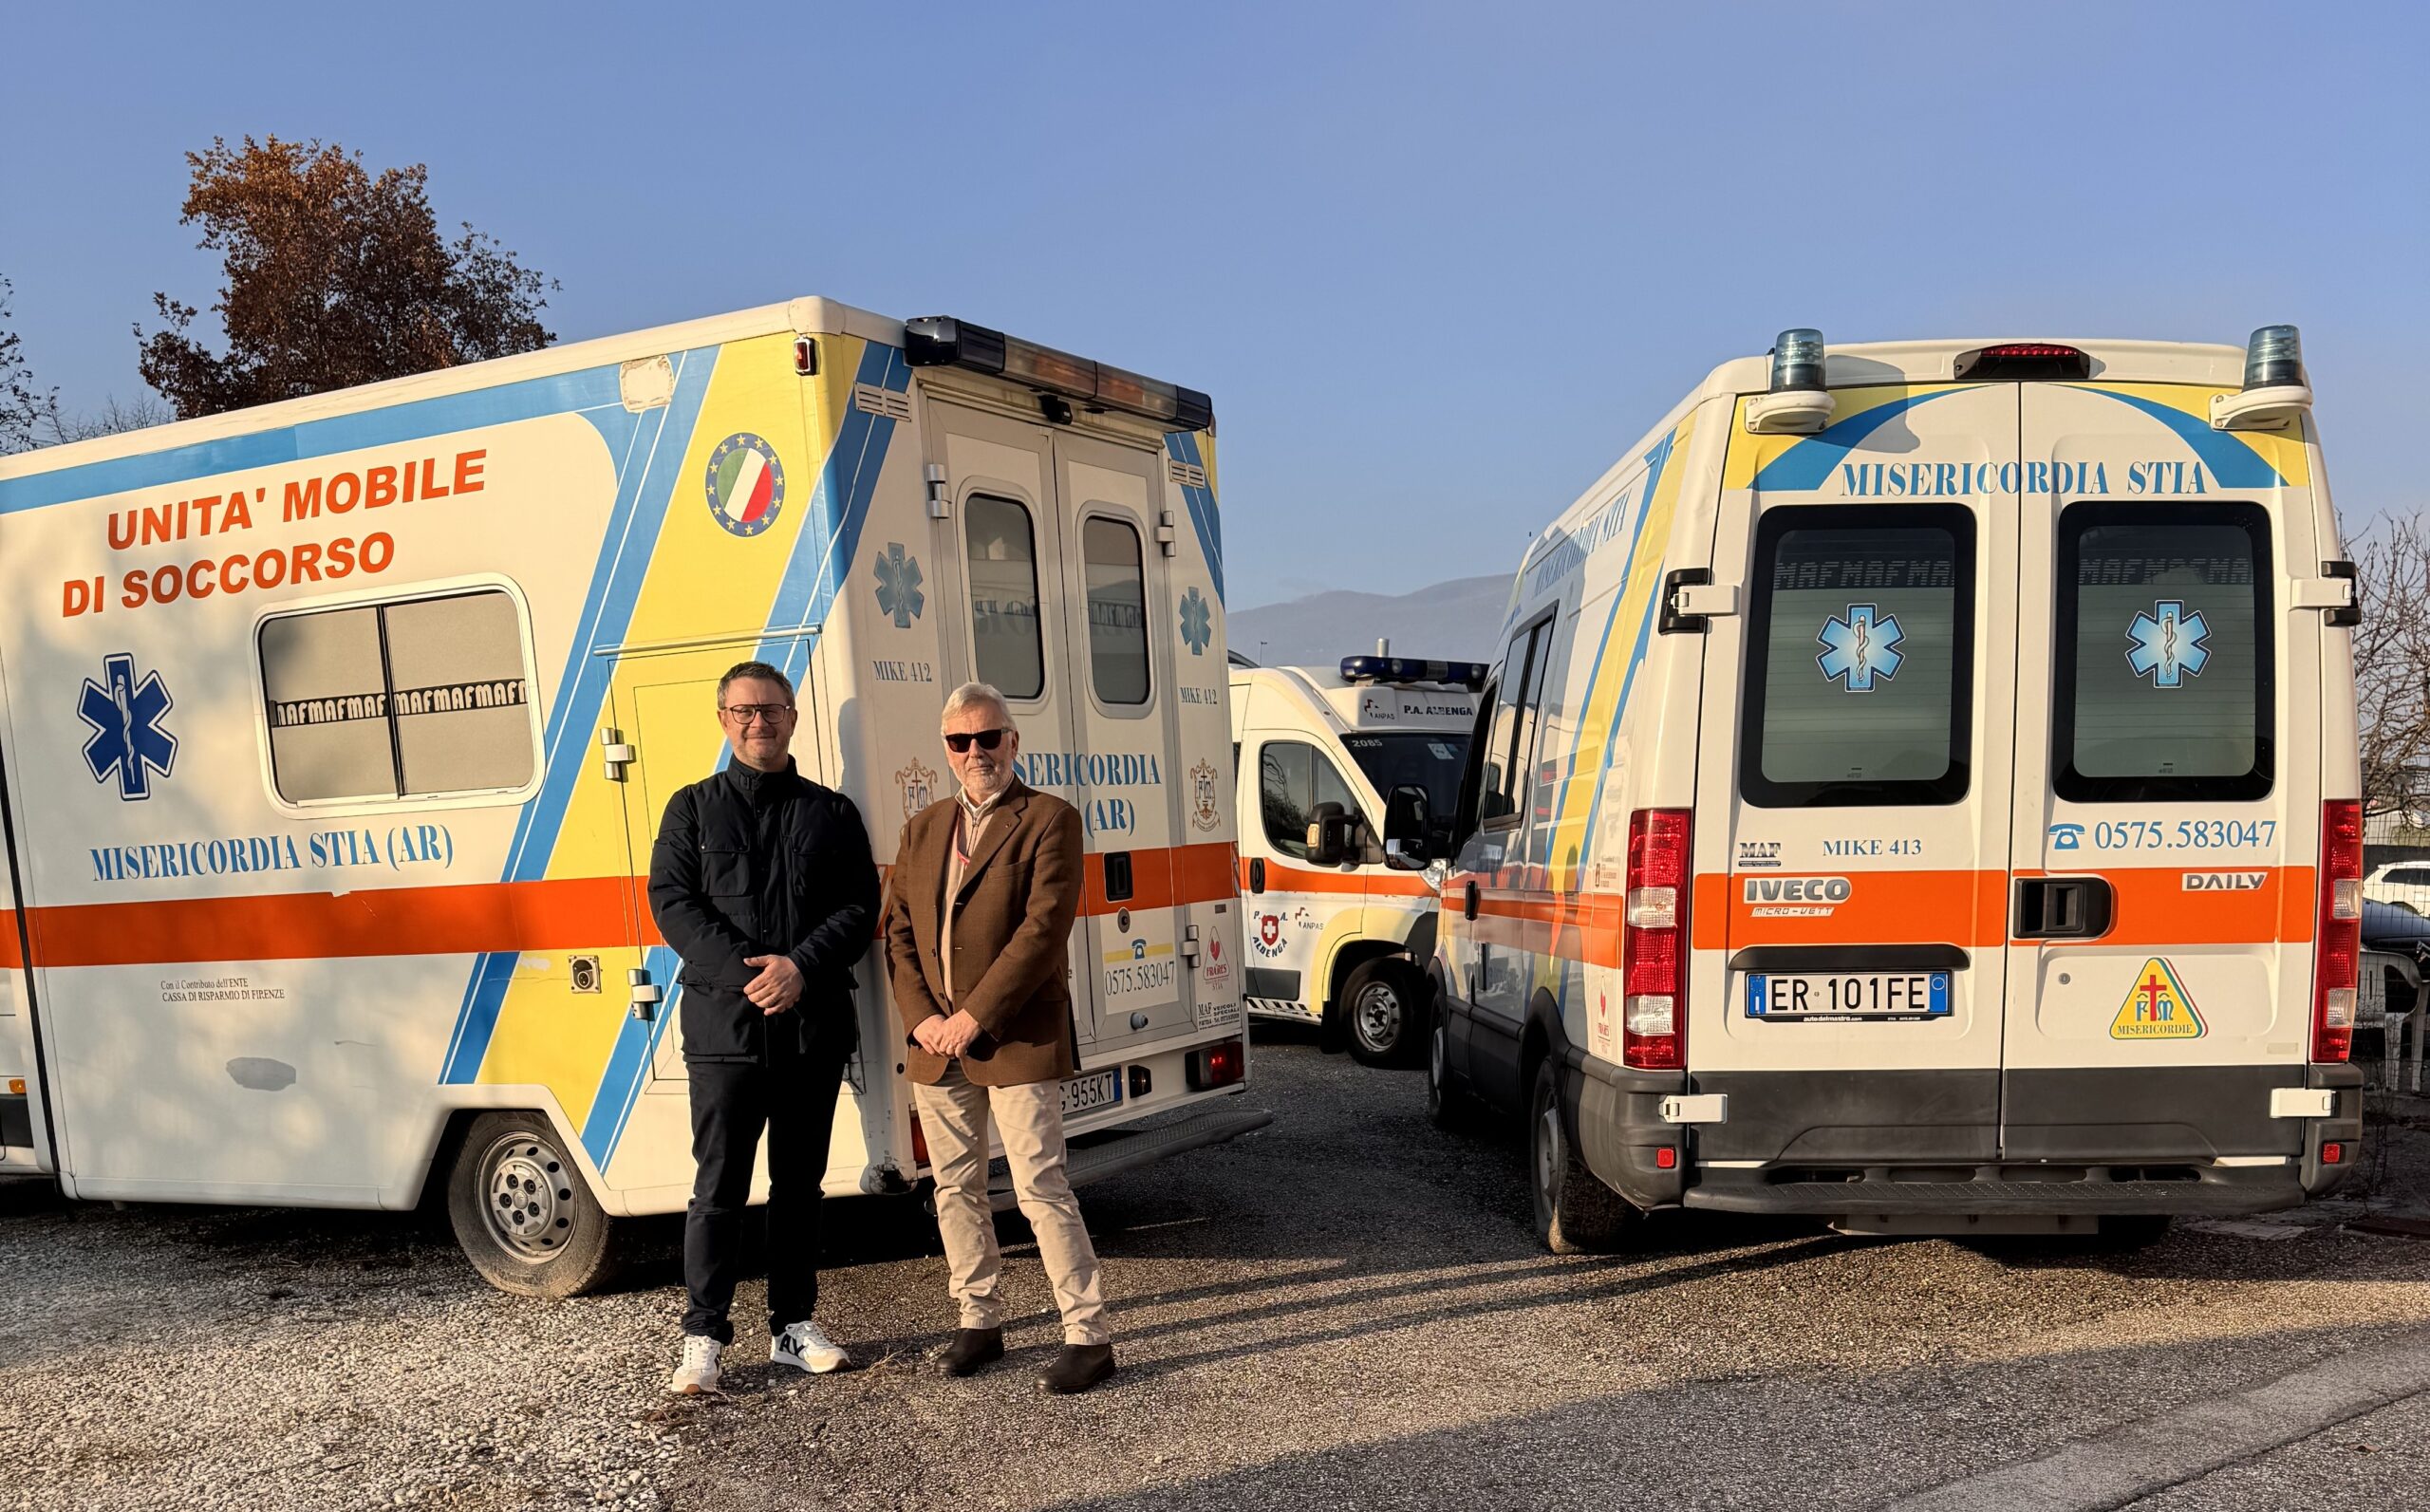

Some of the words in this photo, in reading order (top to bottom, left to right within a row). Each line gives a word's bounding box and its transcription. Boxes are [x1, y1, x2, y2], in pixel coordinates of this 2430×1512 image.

[1841, 461, 2110, 496] MISERICORDIA
[2126, 460, 2208, 495] STIA
[107, 488, 266, 551] UNITA'
[283, 449, 487, 522] MOBILE
[62, 576, 105, 618] DI
[121, 532, 395, 608] SOCCORSO
[873, 661, 907, 681] MIKE
[911, 663, 932, 681] 412
[1180, 687, 1202, 703] MIKE
[1205, 688, 1217, 704] 412
[1352, 739, 1383, 748] 2085
[1012, 753, 1162, 786] SERICORDIA
[1085, 799, 1135, 838] (AR)
[2095, 820, 2276, 849] 0575.583047
[89, 835, 302, 882] MISERICORDIA
[309, 828, 381, 868] STIA
[386, 824, 454, 871] (AR)
[1739, 843, 1781, 858] MAF
[1822, 840, 1882, 856] MIKE
[1889, 839, 1922, 855] 413
[1747, 879, 1851, 902] IVECO
[2186, 874, 2265, 889] DAILY
[1302, 922, 1324, 930] ANPAS
[160, 980, 174, 990] Con
[181, 980, 215, 989] Contributo
[1105, 961, 1175, 996] 0575.583047
[162, 992, 187, 1002] CASSA
[189, 992, 197, 1001] DI
[198, 991, 240, 1001] RISPARMIO
[241, 990, 251, 999] DI
[252, 989, 285, 999] FIRENZE
[1771, 979, 1809, 1010] ER
[1828, 978, 1925, 1010] 101FE
[2117, 1024, 2193, 1036] MISERICORDIE
[1071, 1073, 1112, 1108] 955KT
